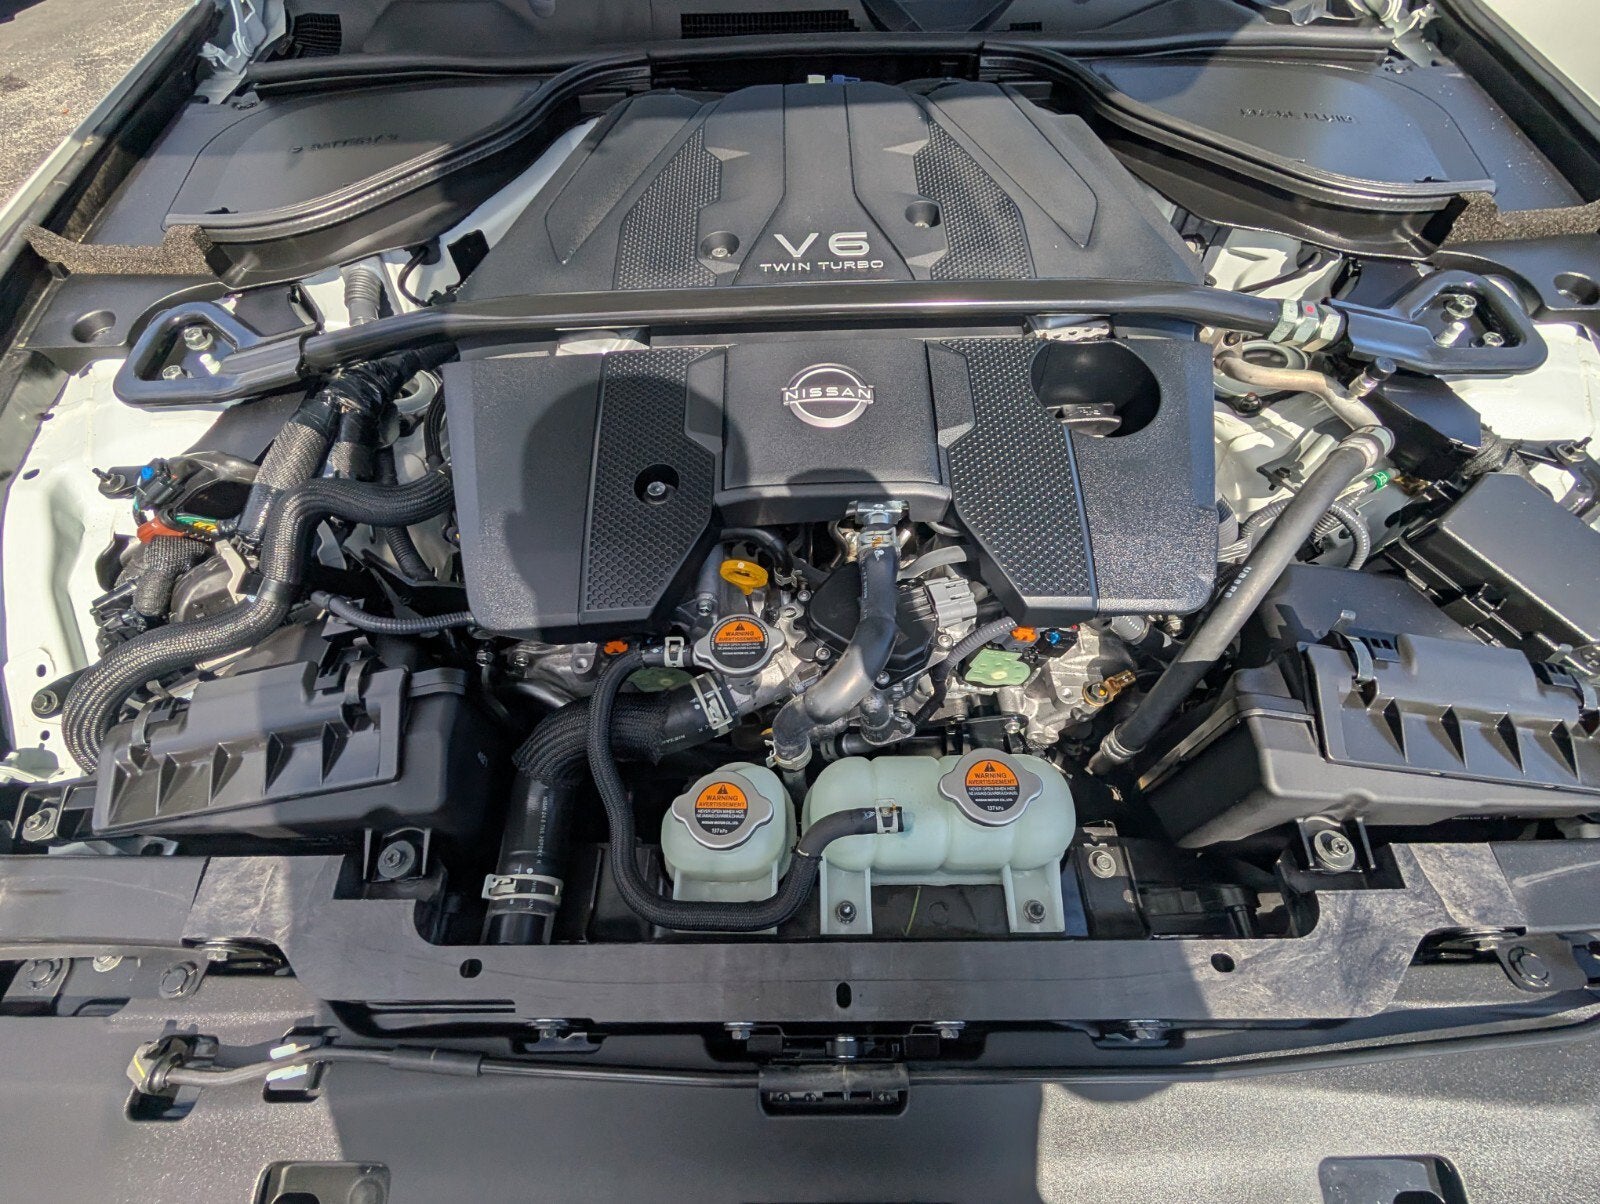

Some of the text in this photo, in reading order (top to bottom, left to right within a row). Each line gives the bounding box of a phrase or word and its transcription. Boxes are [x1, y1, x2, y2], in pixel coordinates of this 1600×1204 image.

[774, 232, 870, 258] V6
[760, 260, 884, 272] TWIN TURBO
[785, 386, 872, 401] NISSAN
